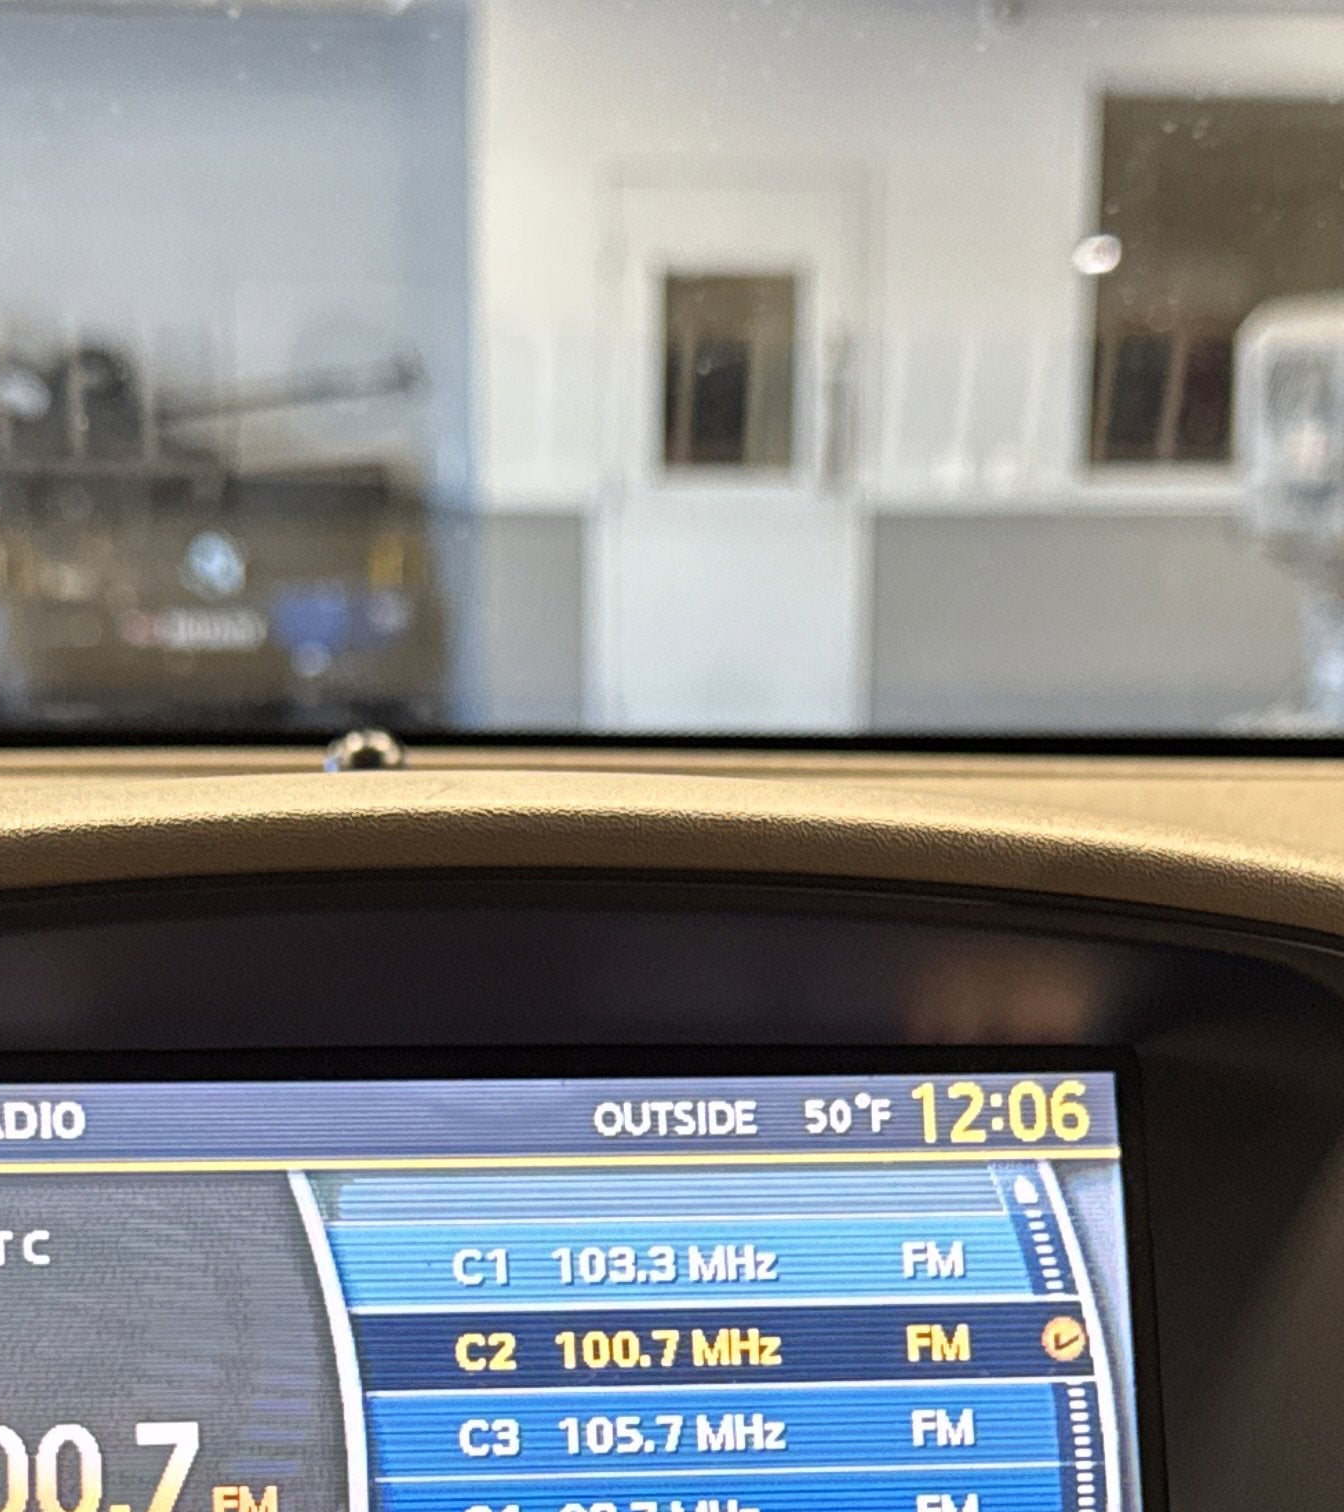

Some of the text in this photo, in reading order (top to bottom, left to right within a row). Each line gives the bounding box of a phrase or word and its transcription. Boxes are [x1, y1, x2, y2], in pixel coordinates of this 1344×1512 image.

[593, 1093, 892, 1137] OUTSIDE 50°F
[912, 1080, 1090, 1144] 12:06
[23, 1230, 50, 1265] C
[453, 1240, 966, 1288] C1 103.3 MHz FM
[455, 1325, 971, 1370] C2 100.7 MHz FM
[459, 1409, 975, 1457] C3 105.7 MHz FM
